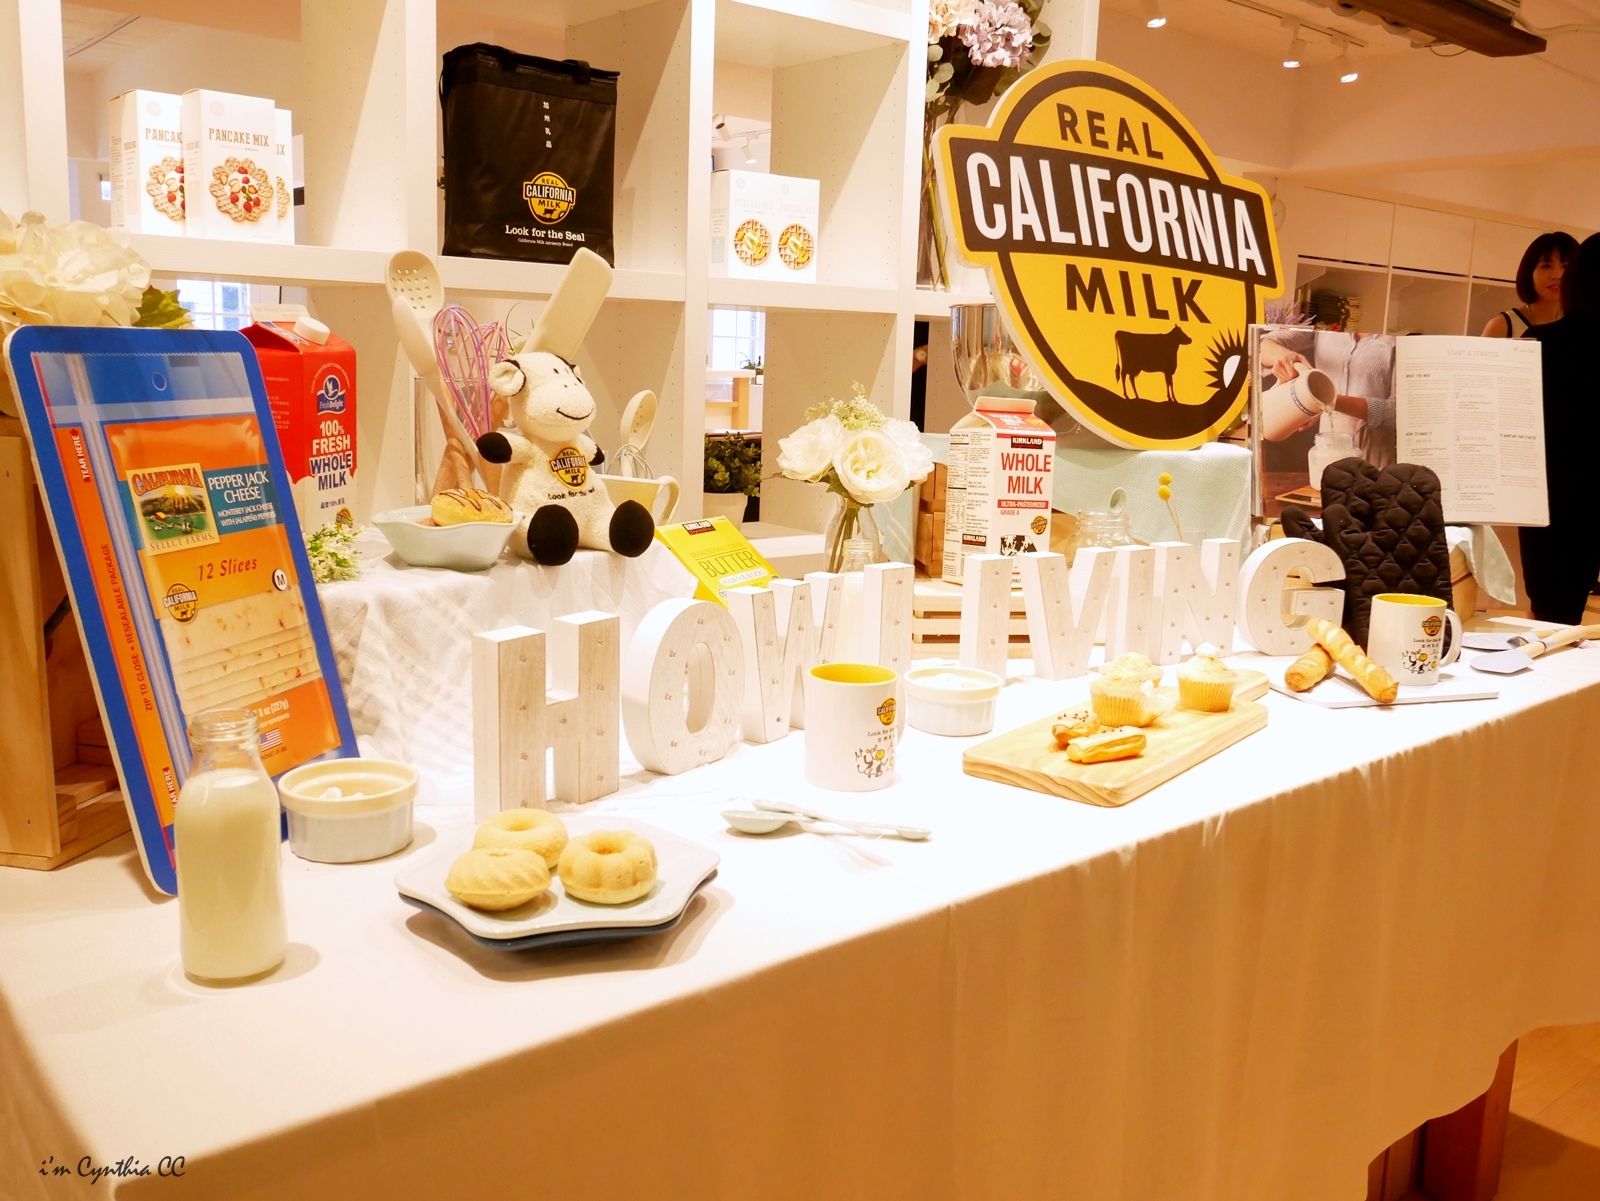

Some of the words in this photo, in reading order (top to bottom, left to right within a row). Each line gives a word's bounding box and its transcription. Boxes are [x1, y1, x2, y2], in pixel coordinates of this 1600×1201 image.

[208, 127, 251, 145] PANCAKE
[252, 133, 270, 148] MIX
[1056, 102, 1164, 161] REAL
[541, 178, 559, 186] REAL
[526, 184, 573, 203] CALIFORNIA
[537, 199, 561, 209] MILK
[965, 152, 1268, 277] CALIFORNIA
[504, 224, 530, 236] Look
[531, 227, 547, 238] for
[547, 230, 564, 240] the
[565, 231, 586, 242] Seal
[1065, 263, 1212, 324] MILK
[319, 419, 345, 437] 100%
[71, 434, 84, 458] HERE
[312, 434, 351, 456] FRESH
[1012, 436, 1043, 446] KIRKLAND
[79, 457, 91, 480] TEAR
[309, 452, 352, 475] WHOLE
[1000, 452, 1052, 473] WHOLE
[131, 467, 203, 497] CALIFORNIA
[207, 473, 246, 491] PEPPER
[245, 470, 269, 486] JACK
[318, 470, 347, 492] MILK
[1007, 475, 1044, 495] MILK
[223, 486, 262, 504] CHEESE
[1000, 500, 1046, 509] ULTRA-PASTEURIZED
[217, 507, 244, 518] MONTEREY
[244, 504, 257, 513] JACK
[256, 501, 274, 512] CHEESE
[220, 519, 235, 527] WITH
[256, 511, 277, 523] PEPPERS
[150, 539, 183, 552] SELECT
[100, 543, 118, 585] PACKAGE
[198, 562, 214, 582] 12
[219, 558, 258, 577] Slices
[697, 550, 762, 579] BUTTER
[276, 573, 286, 588] M
[162, 591, 198, 608] CALIFORNIA
[174, 603, 192, 612] MILK
[112, 585, 135, 644] RESEALABLE
[130, 652, 146, 685] CLOSE
[140, 683, 148, 696] TO
[143, 696, 153, 712] ZIP
[258, 707, 264, 718] 8
[263, 706, 271, 716] oz
[163, 769, 176, 791] HERE
